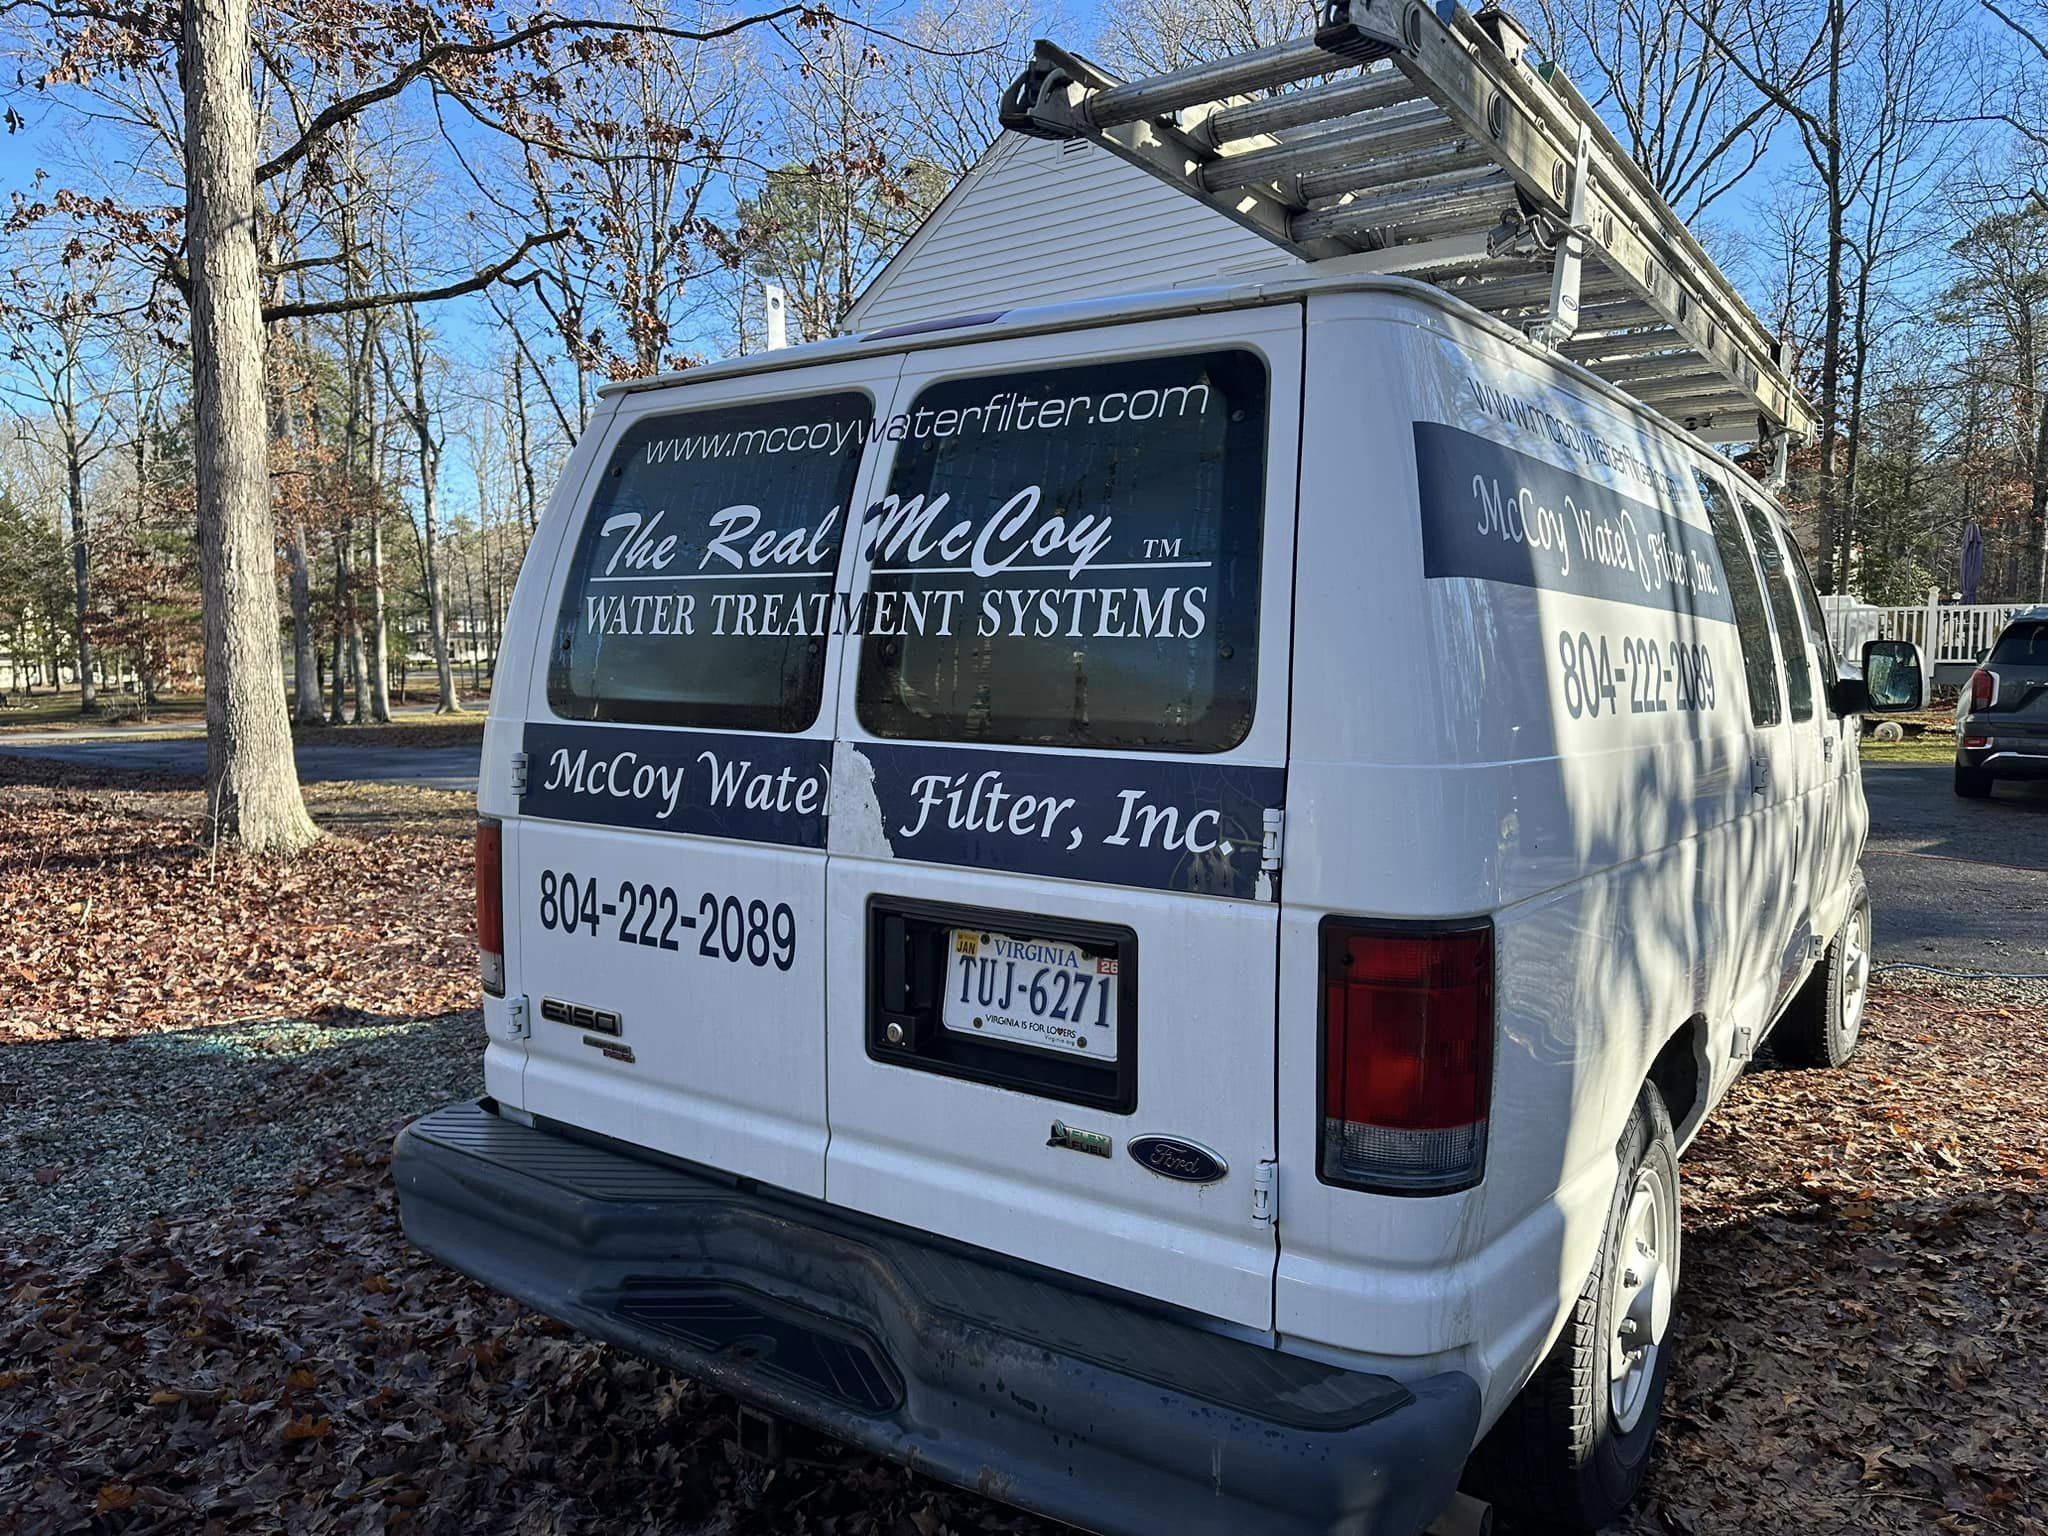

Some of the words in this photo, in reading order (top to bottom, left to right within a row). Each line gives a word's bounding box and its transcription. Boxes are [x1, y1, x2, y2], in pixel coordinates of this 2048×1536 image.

[646, 384, 1209, 464] www.mccoywaterfilter.com
[600, 510, 678, 577] The
[698, 505, 840, 571] Real
[863, 485, 1113, 581] McCoy
[1142, 538, 1183, 558] TM
[1473, 474, 1569, 576] McCoy
[586, 594, 695, 637] WATER
[711, 589, 964, 638] TREATMENT
[976, 586, 1208, 640] SYSTEMS
[1559, 630, 1715, 720] 804-222-2089
[544, 748, 685, 819] McCoy
[899, 770, 1083, 852] Filter,
[1103, 789, 1233, 857] Inc.
[540, 869, 796, 971] 804-222-2089
[957, 940, 976, 955] JAN
[994, 938, 1080, 969] VIRGINIA
[1101, 960, 1119, 974] 26
[959, 956, 1111, 1029] TUJ-6271
[985, 1014, 1020, 1029] VIRGINIA
[1021, 1020, 1028, 1030] IS
[1029, 1022, 1045, 1033] FOR
[1071, 1129, 1108, 1146] FLEX
[1150, 1143, 1201, 1174] Ford
